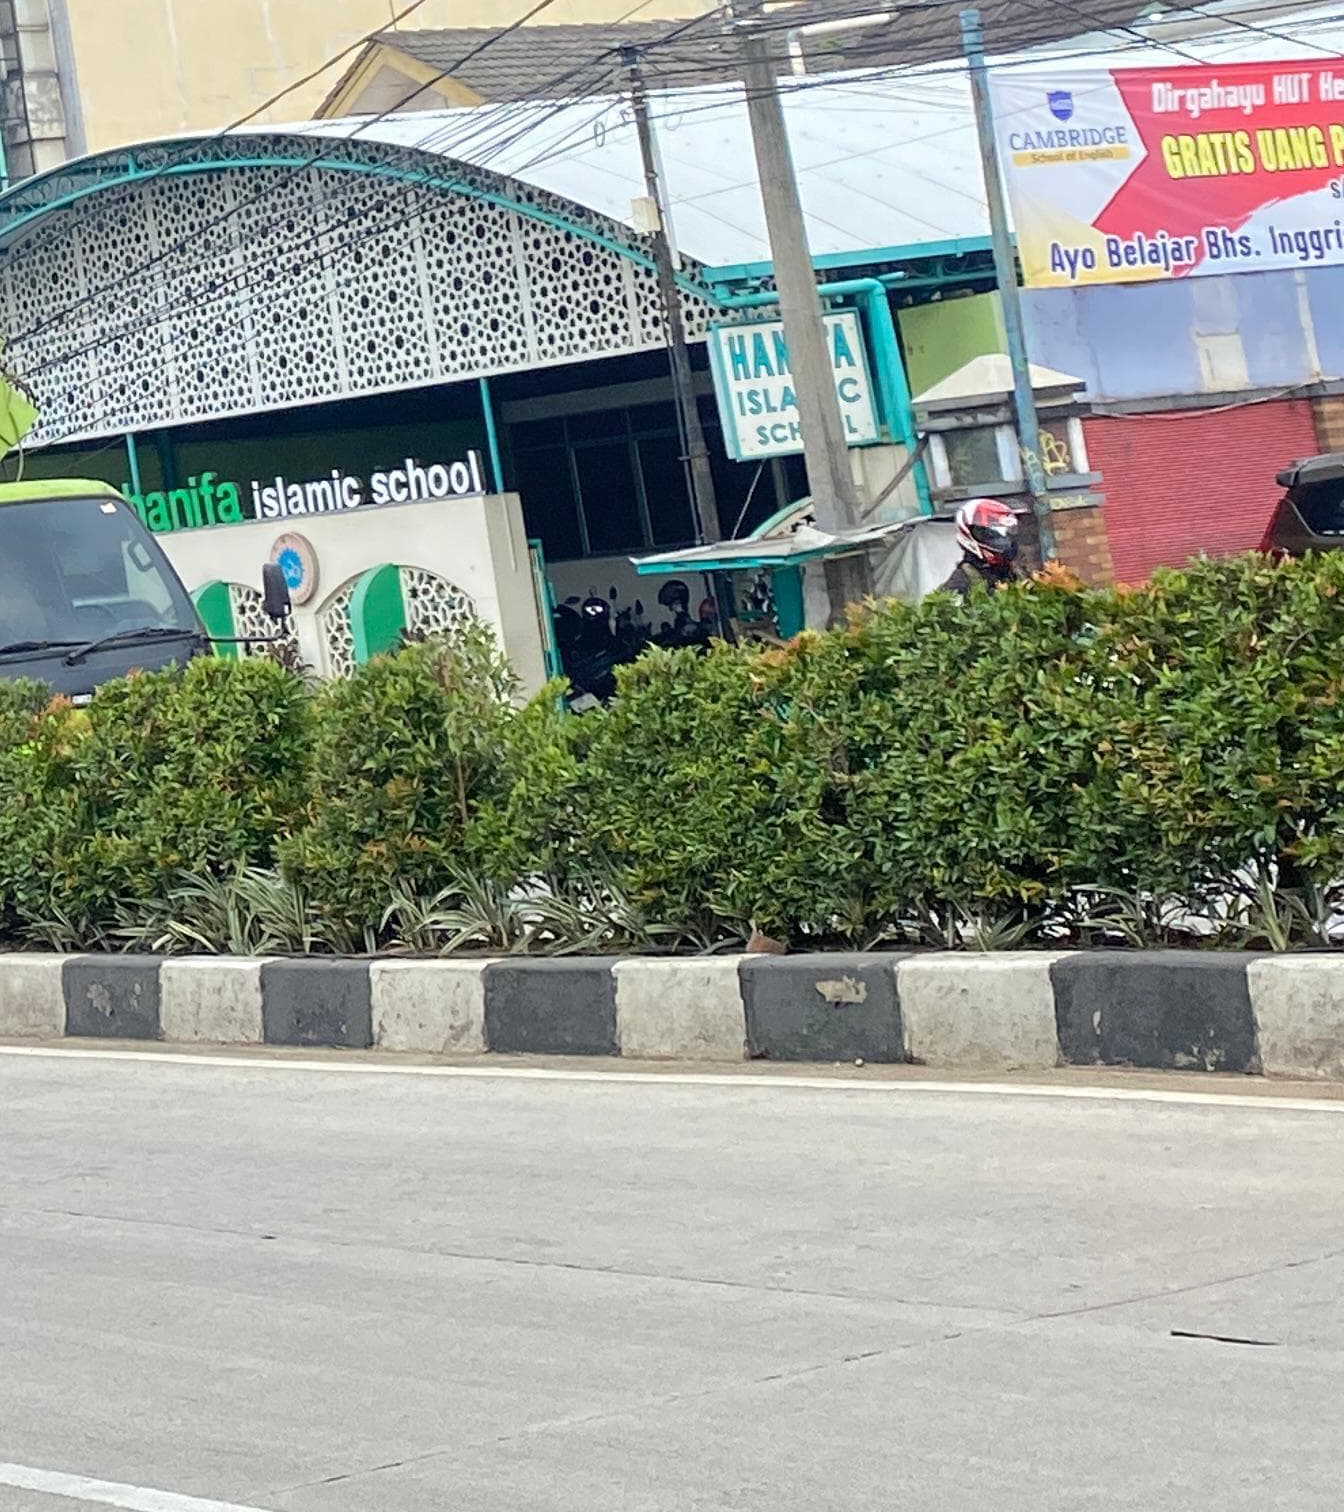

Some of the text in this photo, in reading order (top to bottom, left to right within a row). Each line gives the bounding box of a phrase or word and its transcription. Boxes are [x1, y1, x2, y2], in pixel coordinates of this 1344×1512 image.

[1152, 80, 1265, 117] Dirgahayu
[1273, 73, 1311, 104] HUT
[1009, 126, 1128, 150] CAMBRIDGE
[1161, 130, 1255, 179] GRATIS
[1257, 125, 1329, 172] UANG
[1051, 242, 1095, 278] Ayo
[1106, 233, 1196, 270] Belajar
[1205, 230, 1261, 258] Bhs.
[728, 322, 855, 381] HANA
[736, 377, 862, 416] ISLAC
[756, 414, 858, 445] SCHL
[121, 450, 483, 532] hanifa islamic school
